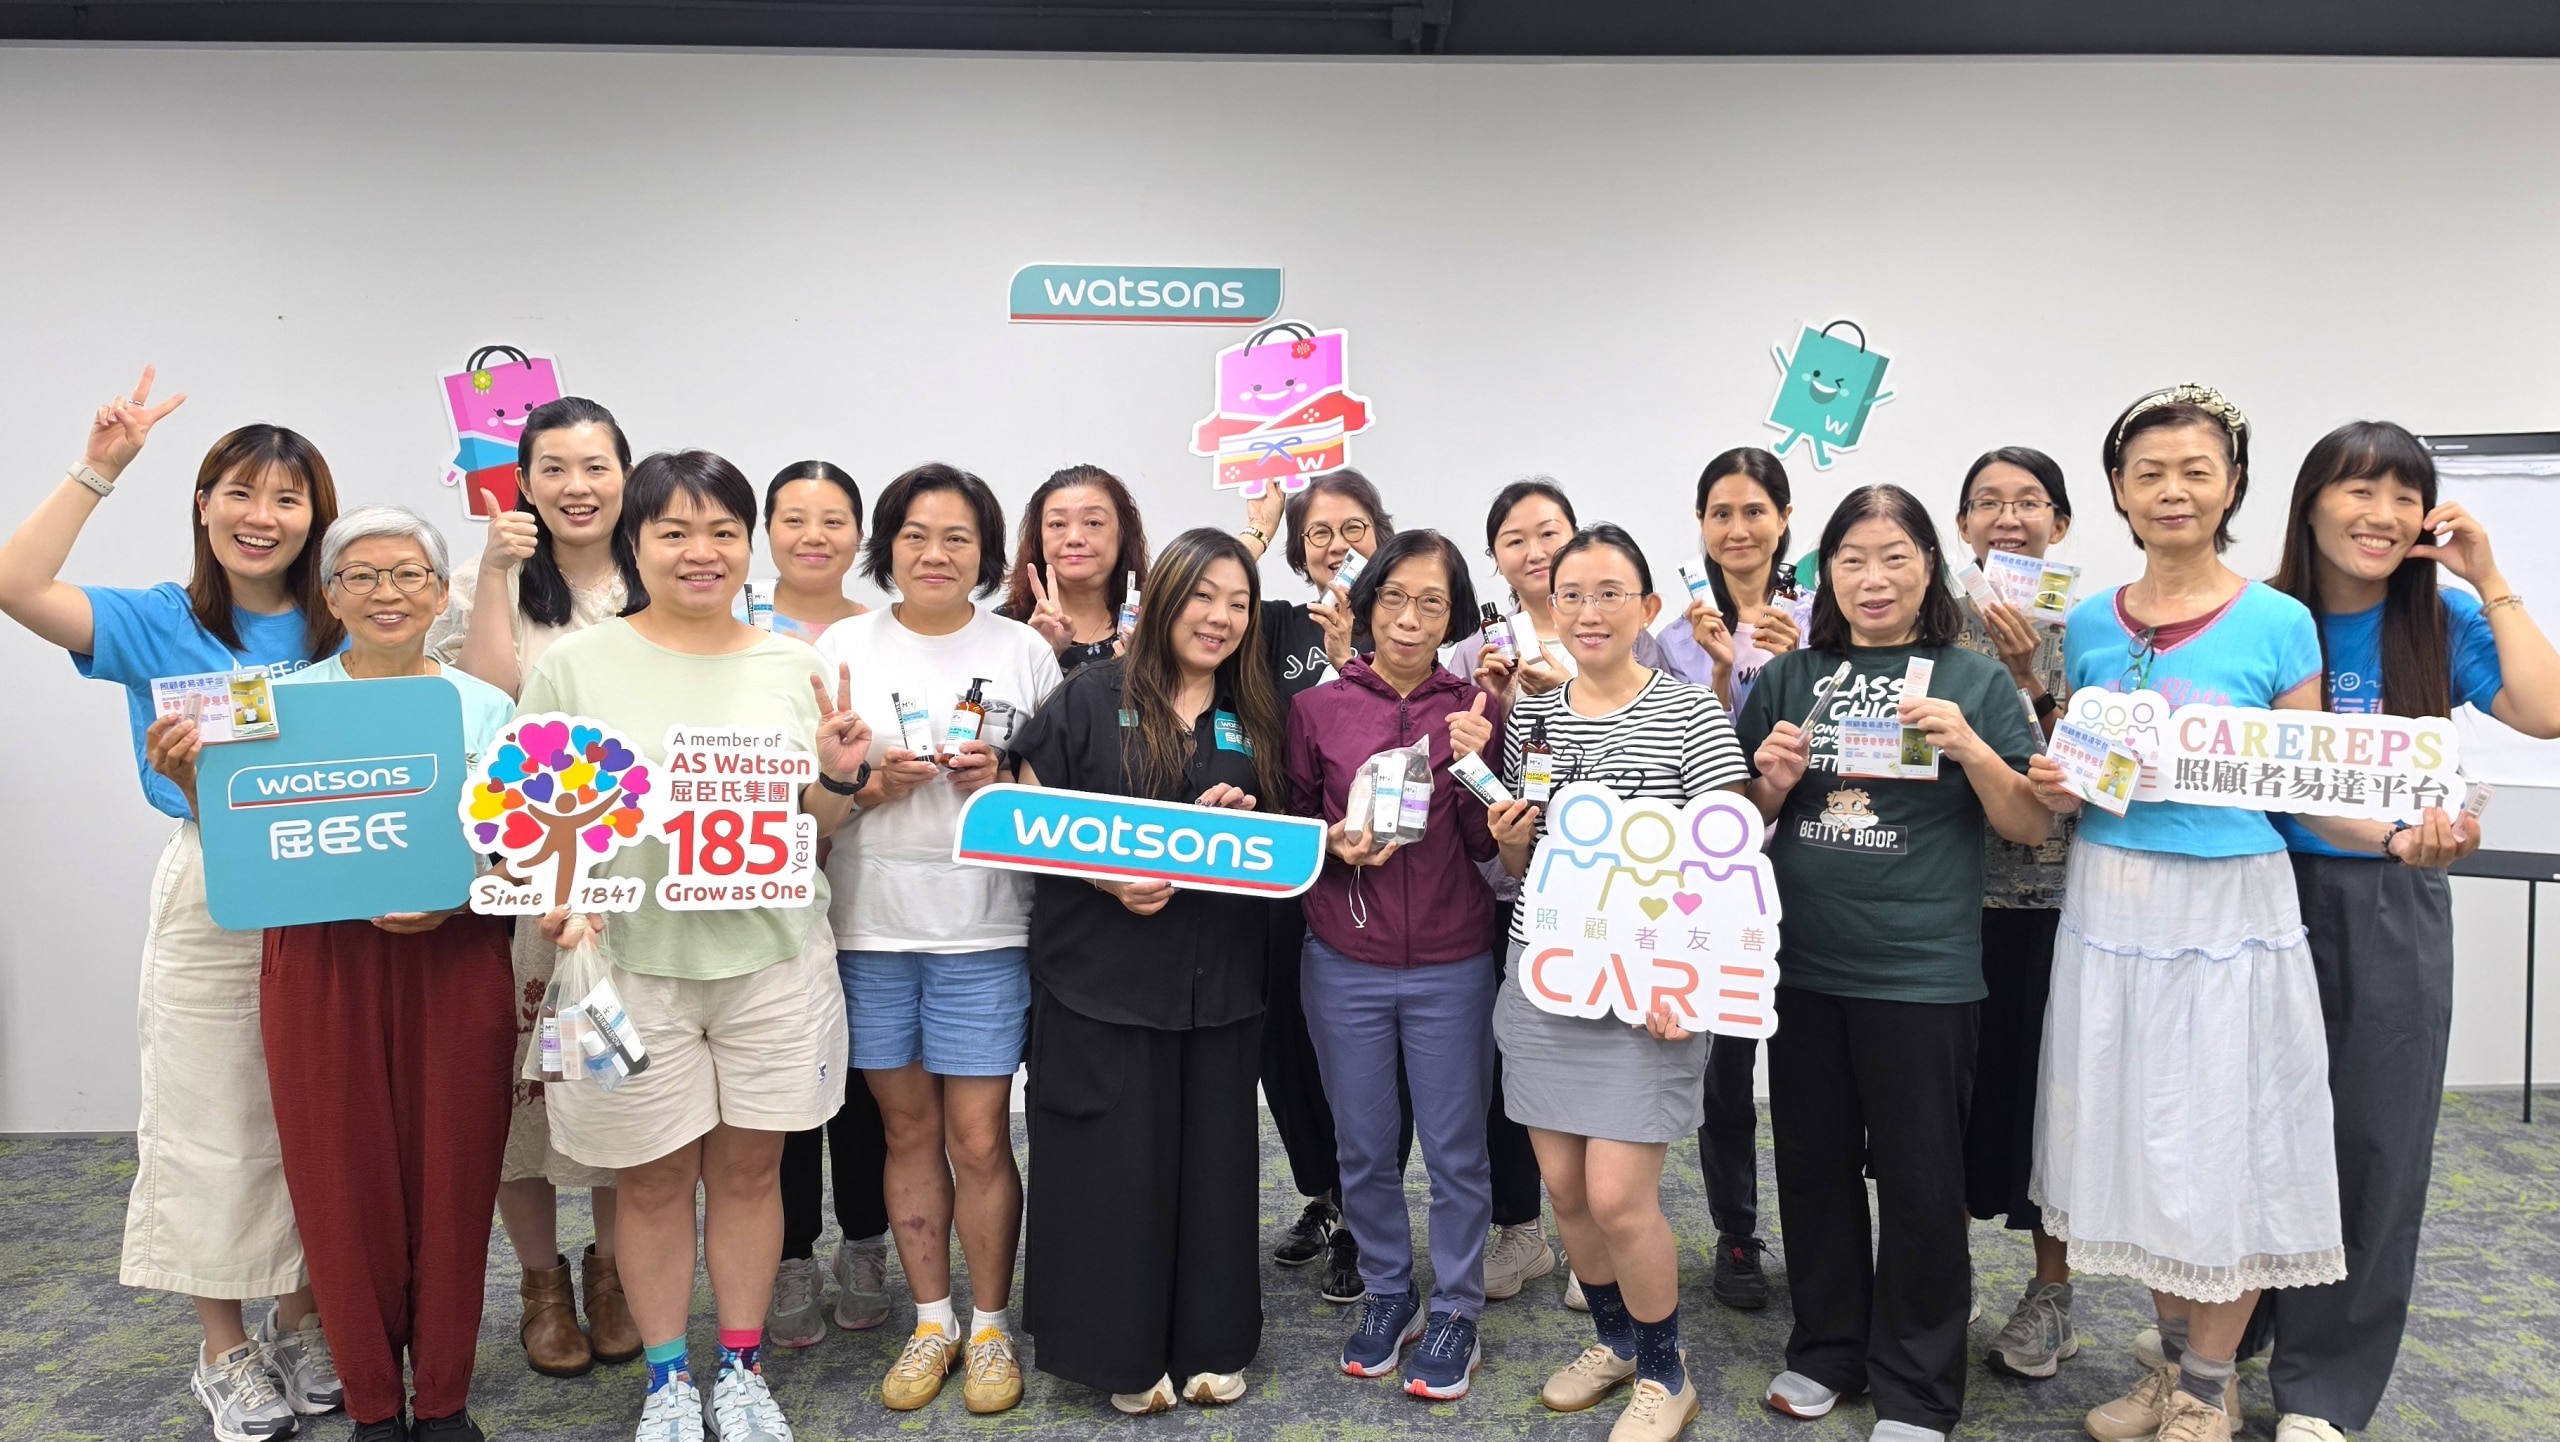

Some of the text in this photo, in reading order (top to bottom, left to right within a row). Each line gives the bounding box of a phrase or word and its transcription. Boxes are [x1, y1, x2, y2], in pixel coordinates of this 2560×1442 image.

[1044, 276, 1245, 308] watsons
[673, 732, 782, 747] A member of
[2179, 717, 2443, 770] CAREREPS
[670, 752, 811, 775] AS Watson
[256, 766, 411, 796] watsons
[670, 780, 790, 803] 屈臣氏集團
[2174, 757, 2450, 810] 照顧者易達平台
[269, 811, 409, 861] 屈臣氏
[663, 809, 789, 876] 185
[791, 821, 810, 874] Years
[1013, 808, 1274, 871] watsons
[1799, 820, 1840, 843] BETTY
[480, 884, 637, 906] Since 1841
[665, 881, 807, 902] Grow as One
[1531, 948, 1765, 1026] CARE
